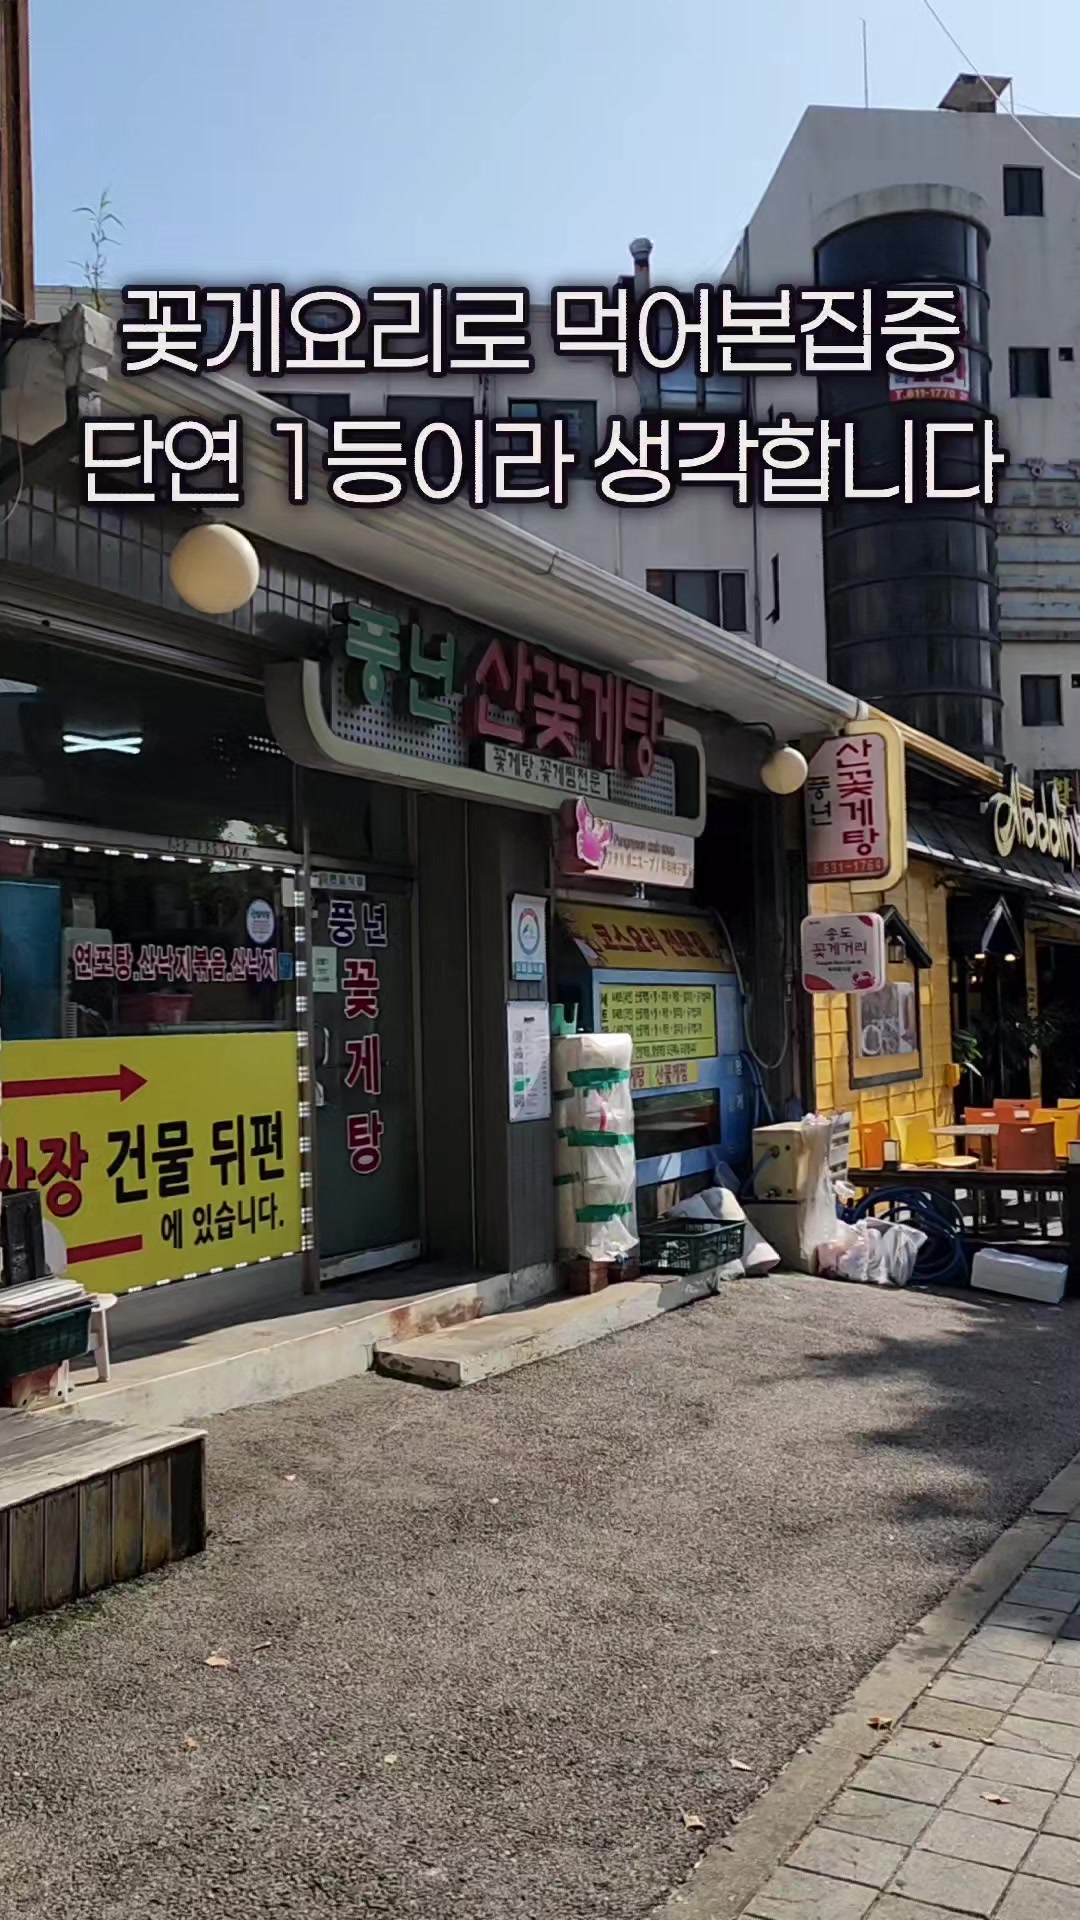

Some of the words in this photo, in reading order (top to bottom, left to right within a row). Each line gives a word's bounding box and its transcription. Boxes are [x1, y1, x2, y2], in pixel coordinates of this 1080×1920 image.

[344, 601, 457, 724] 풍년
[475, 639, 667, 779] 산꽃게탕
[806, 775, 833, 827] 풍년
[835, 739, 880, 856] 산꽃게탕
[327, 900, 389, 947] 풍년
[811, 941, 868, 959] 꽃게거리
[824, 926, 854, 941] 송도
[341, 957, 385, 1176] 꽃게탕
[106, 1120, 194, 1204] 건물
[209, 1110, 285, 1187] 뒤편
[161, 1208, 183, 1249] 에
[192, 1192, 285, 1246] 있습니다.
